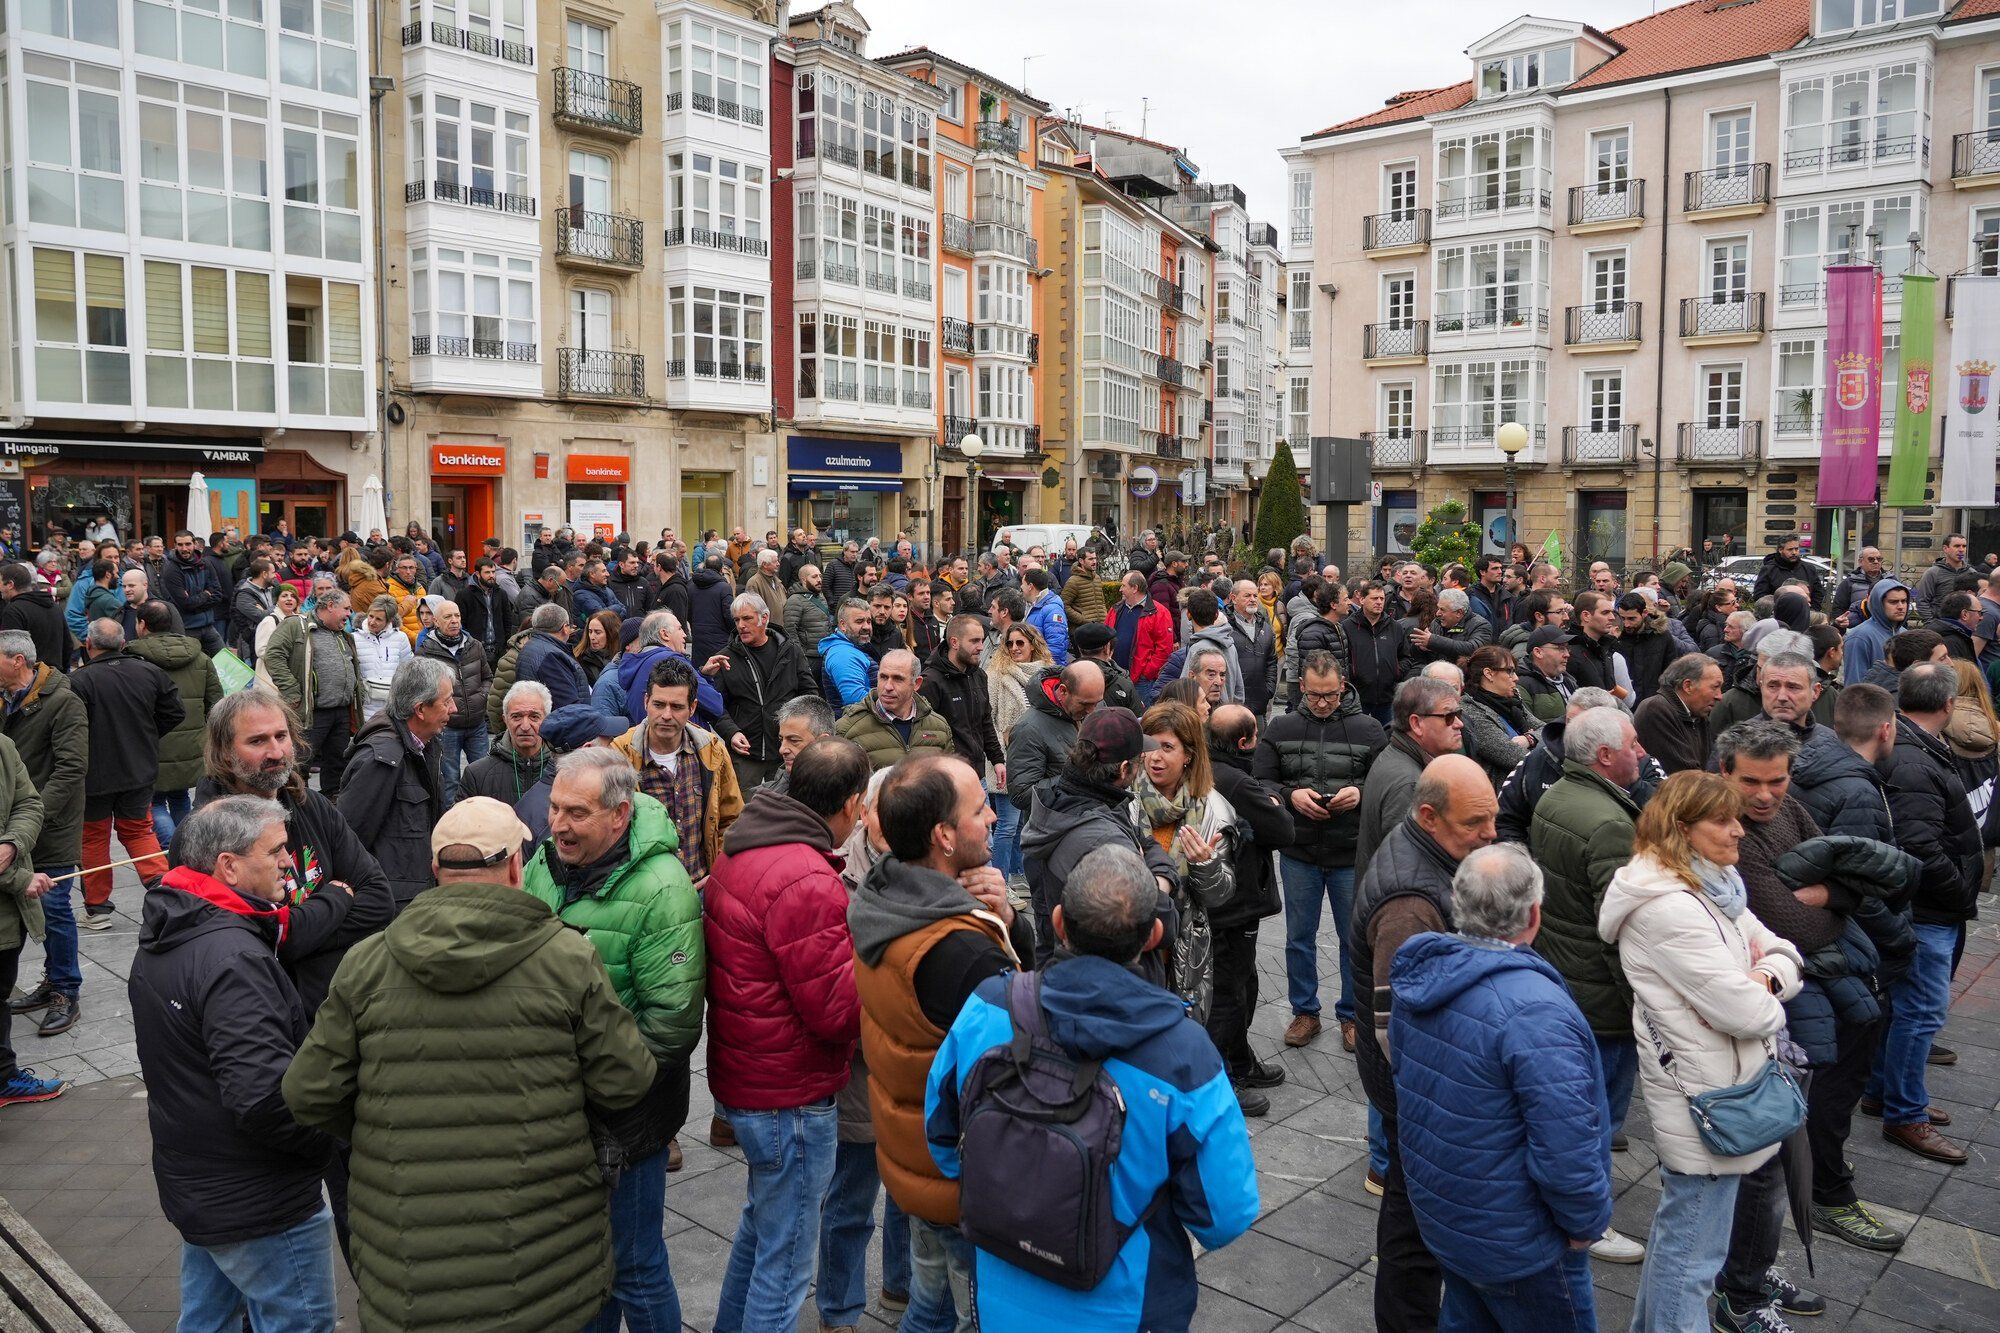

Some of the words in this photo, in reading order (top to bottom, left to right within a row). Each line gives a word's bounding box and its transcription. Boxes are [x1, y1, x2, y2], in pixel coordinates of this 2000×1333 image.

[4, 442, 60, 455] Hungaria
[212, 451, 251, 462] AMBAR
[825, 454, 872, 467] azulmarino
